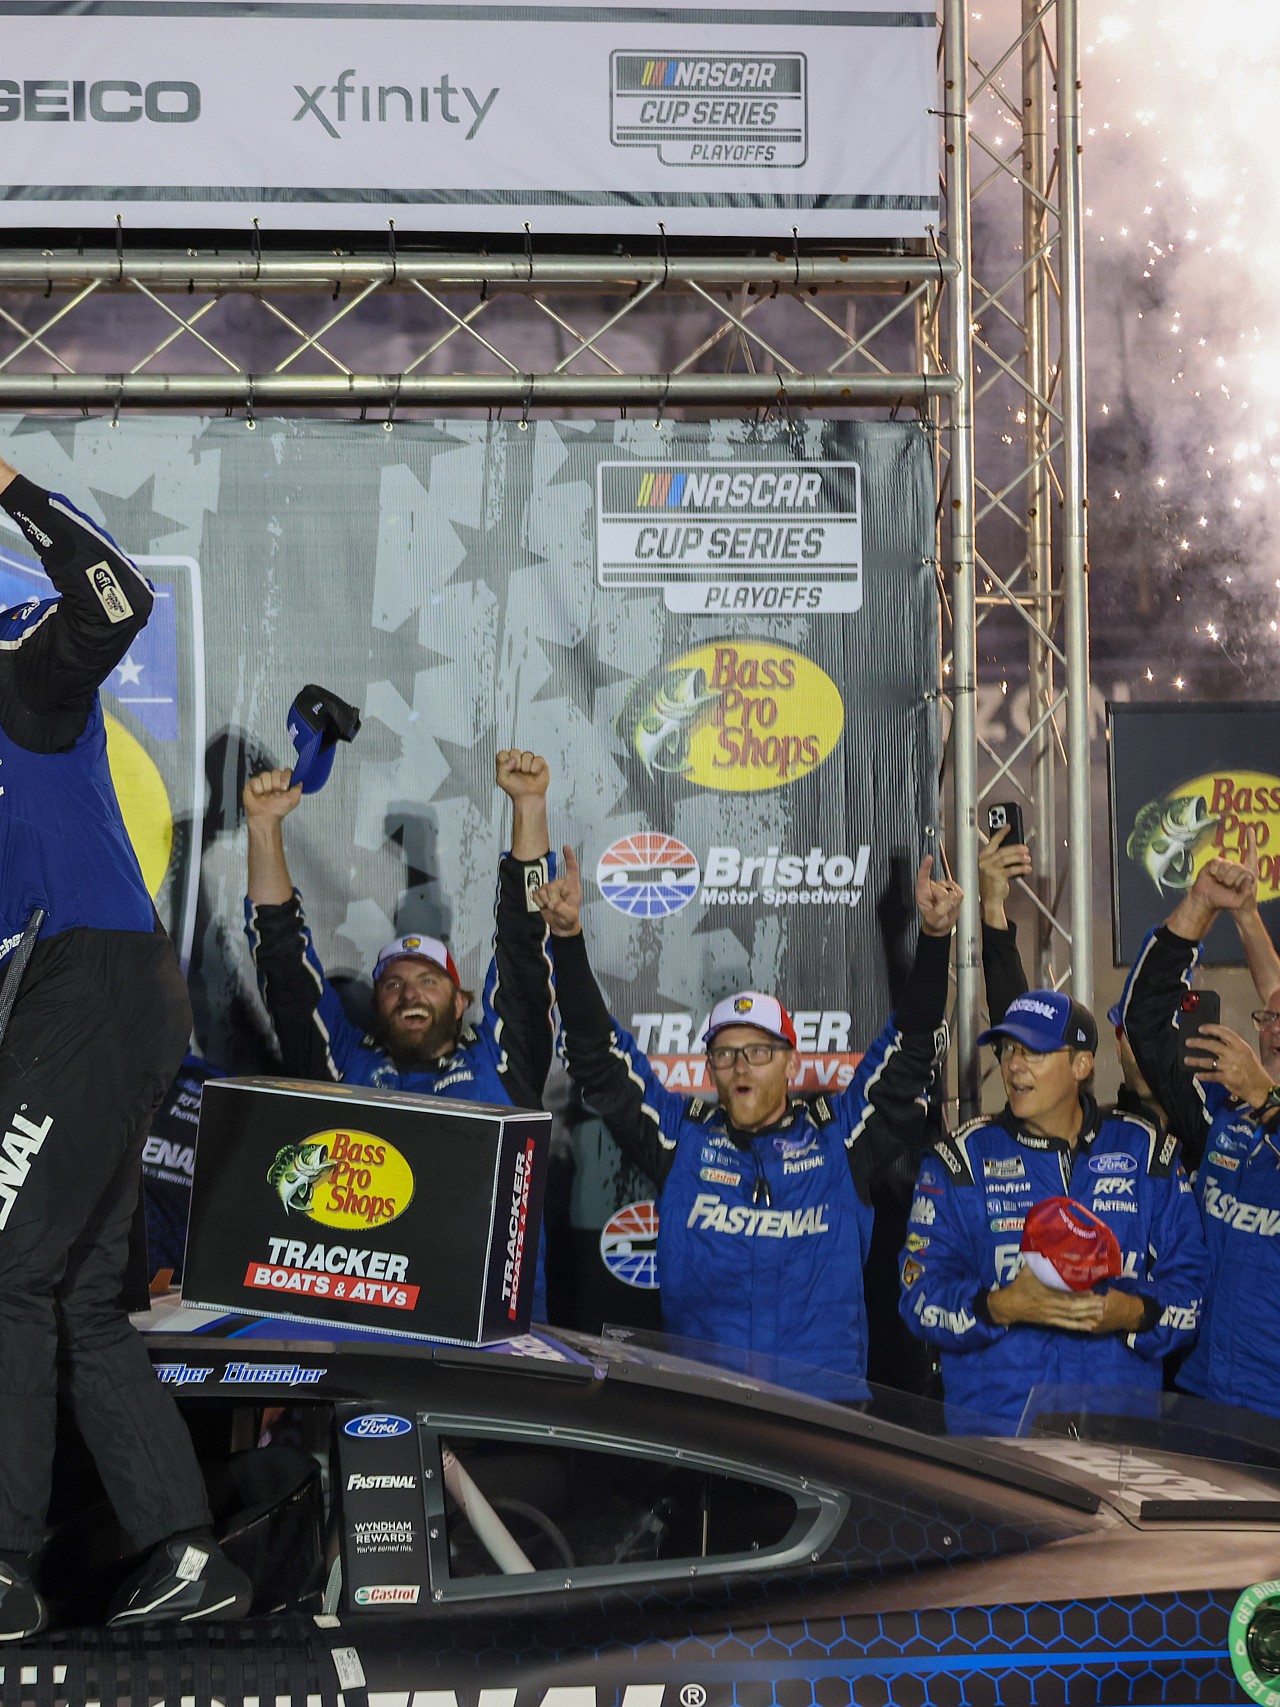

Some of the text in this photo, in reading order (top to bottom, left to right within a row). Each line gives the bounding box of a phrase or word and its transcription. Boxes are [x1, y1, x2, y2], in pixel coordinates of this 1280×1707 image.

[674, 61, 777, 88] NASCAR
[292, 69, 500, 140] xfinity
[639, 100, 778, 126] CUP SERIES
[689, 144, 777, 162] PLAYOFFS
[682, 473, 823, 508] NASCAR
[634, 527, 826, 560] CUP SERIES
[704, 586, 823, 608] PLAYOFFS
[708, 646, 797, 690] Bass
[713, 690, 779, 730] Pro
[711, 726, 821, 779] Shops
[1209, 778, 1280, 814] Bass
[1213, 813, 1270, 848] Pro
[703, 844, 872, 888] Bristol
[700, 887, 862, 907] Motor Speedway
[631, 1011, 852, 1054] TRAER
[327, 1132, 387, 1166] Bass
[328, 1160, 372, 1189] Pro
[708, 1169, 740, 1185] Castrol
[1092, 1177, 1136, 1195] RFK
[325, 1186, 396, 1224] Shops
[687, 1193, 830, 1238] FASTENAL
[1092, 1198, 1138, 1214] FASTENAL
[501, 1150, 526, 1302] TRACKER
[510, 1229, 524, 1311] BOATS
[521, 1149, 533, 1210] ATVs
[1001, 1218, 1025, 1231] Castr
[268, 1236, 410, 1283] TRACKER
[253, 1267, 408, 1307] BOATS & ATVs
[219, 1361, 328, 1387] Buescher
[357, 1416, 400, 1435] Ford
[347, 1473, 417, 1491] FASTENAL
[355, 1521, 412, 1533] WYNDHAM
[356, 1533, 413, 1545] REWARDS
[356, 1545, 377, 1554] You've
[377, 1544, 400, 1553] earned
[371, 1586, 416, 1602] Castrol
[1236, 1596, 1256, 1625] GET
[1241, 1670, 1267, 1697] GET
